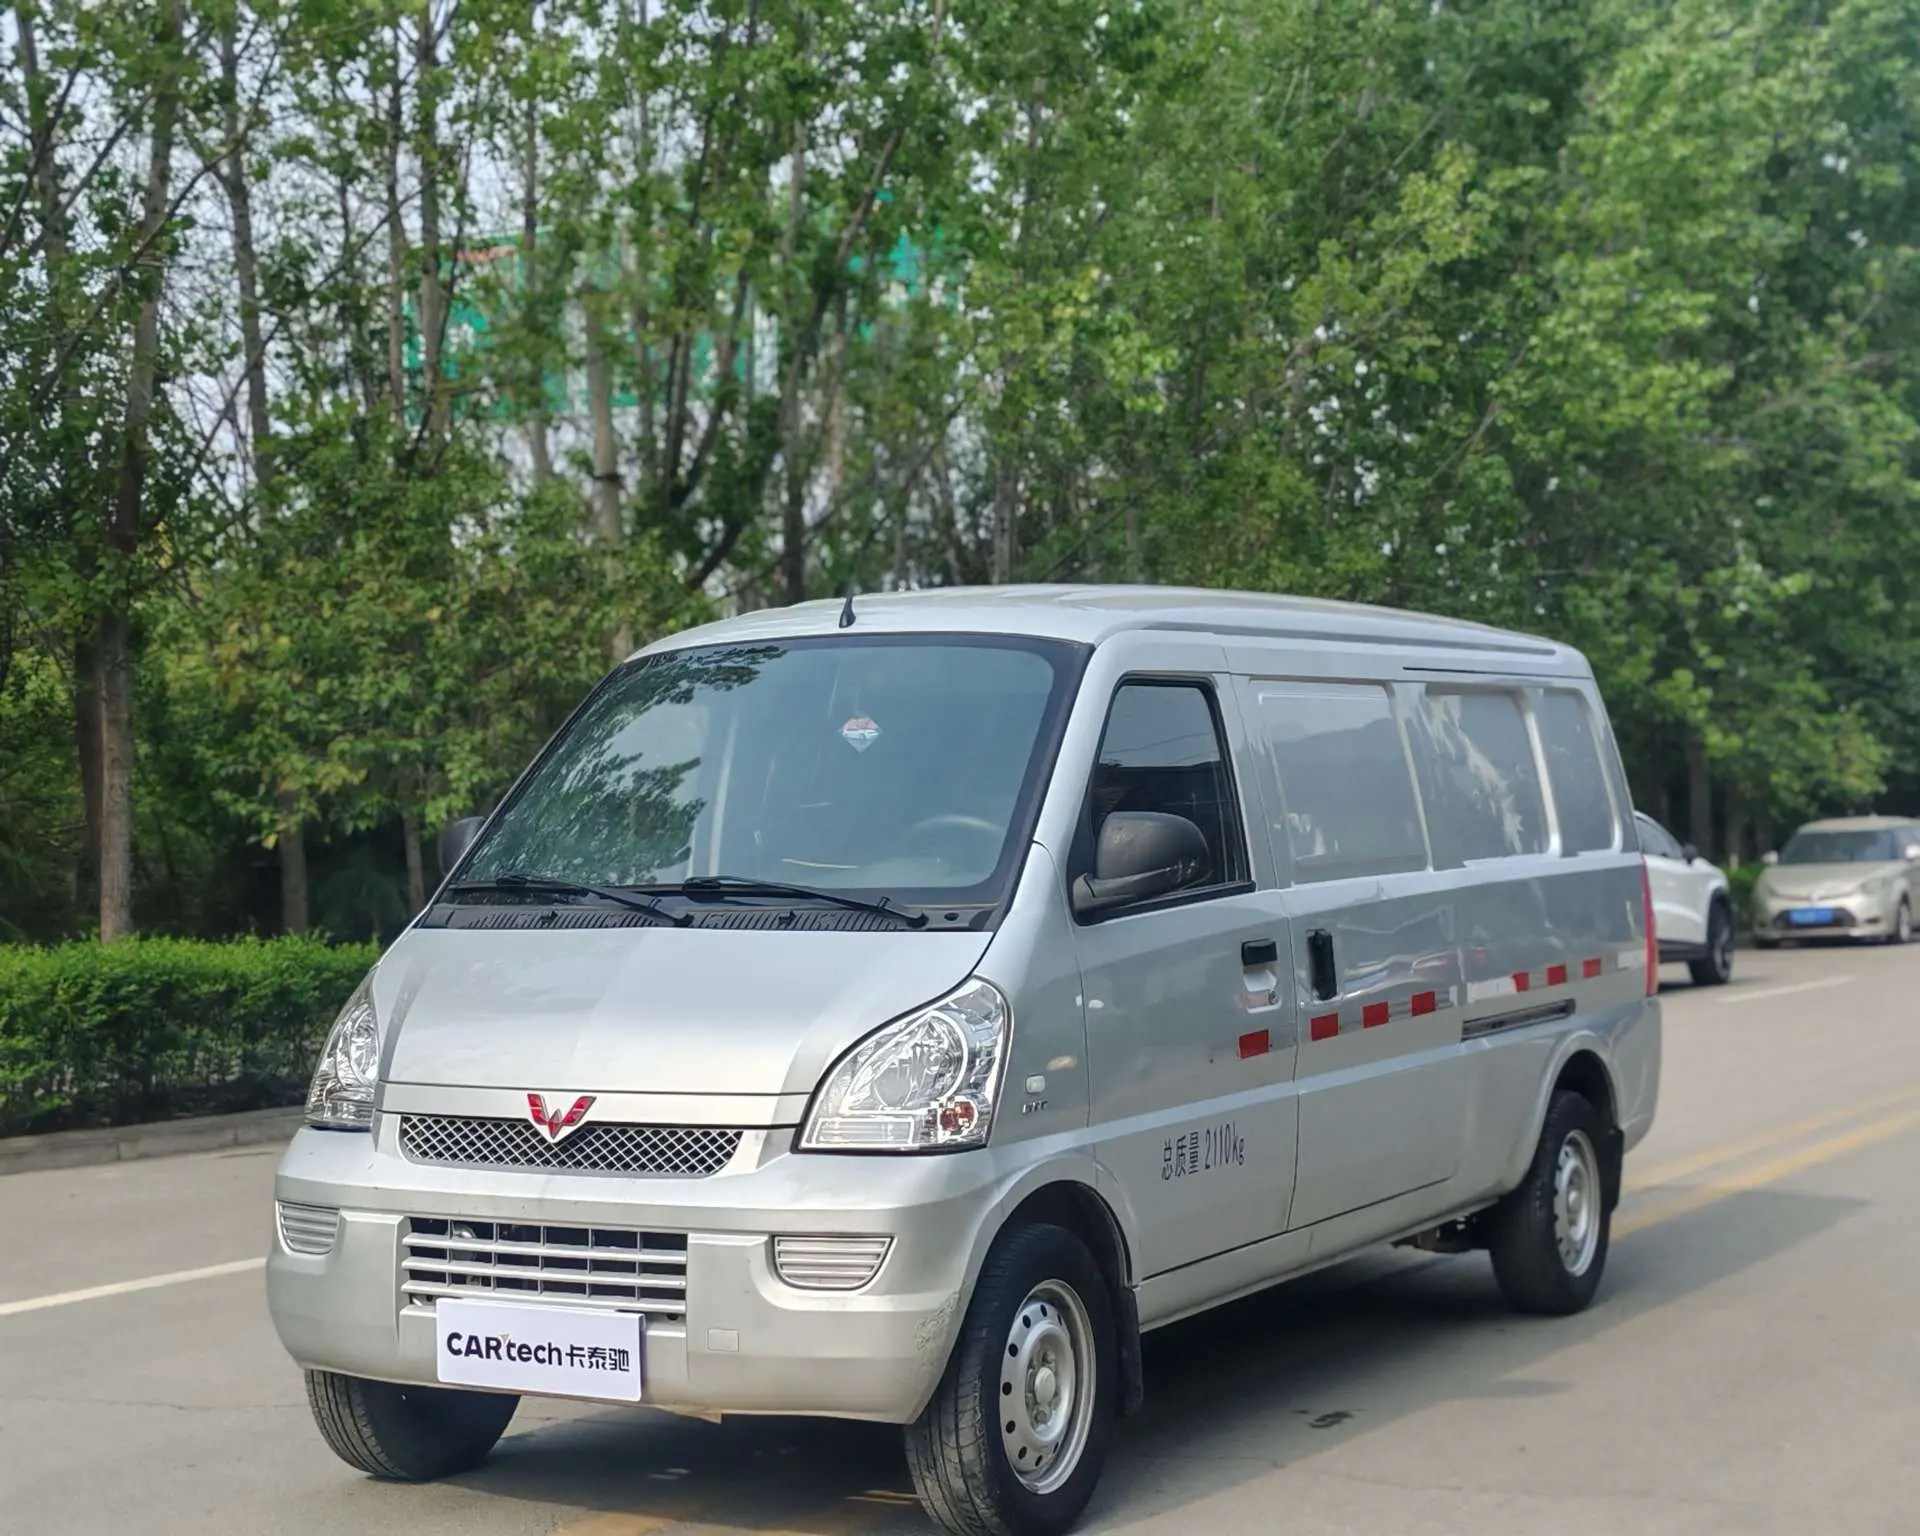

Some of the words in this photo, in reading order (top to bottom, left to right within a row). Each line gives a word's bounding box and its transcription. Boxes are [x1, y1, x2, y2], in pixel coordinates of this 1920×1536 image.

[1161, 1131, 1200, 1181] 总质量
[1204, 1119, 1245, 1170] 2110kg
[565, 1343, 630, 1373] 卡泰驰
